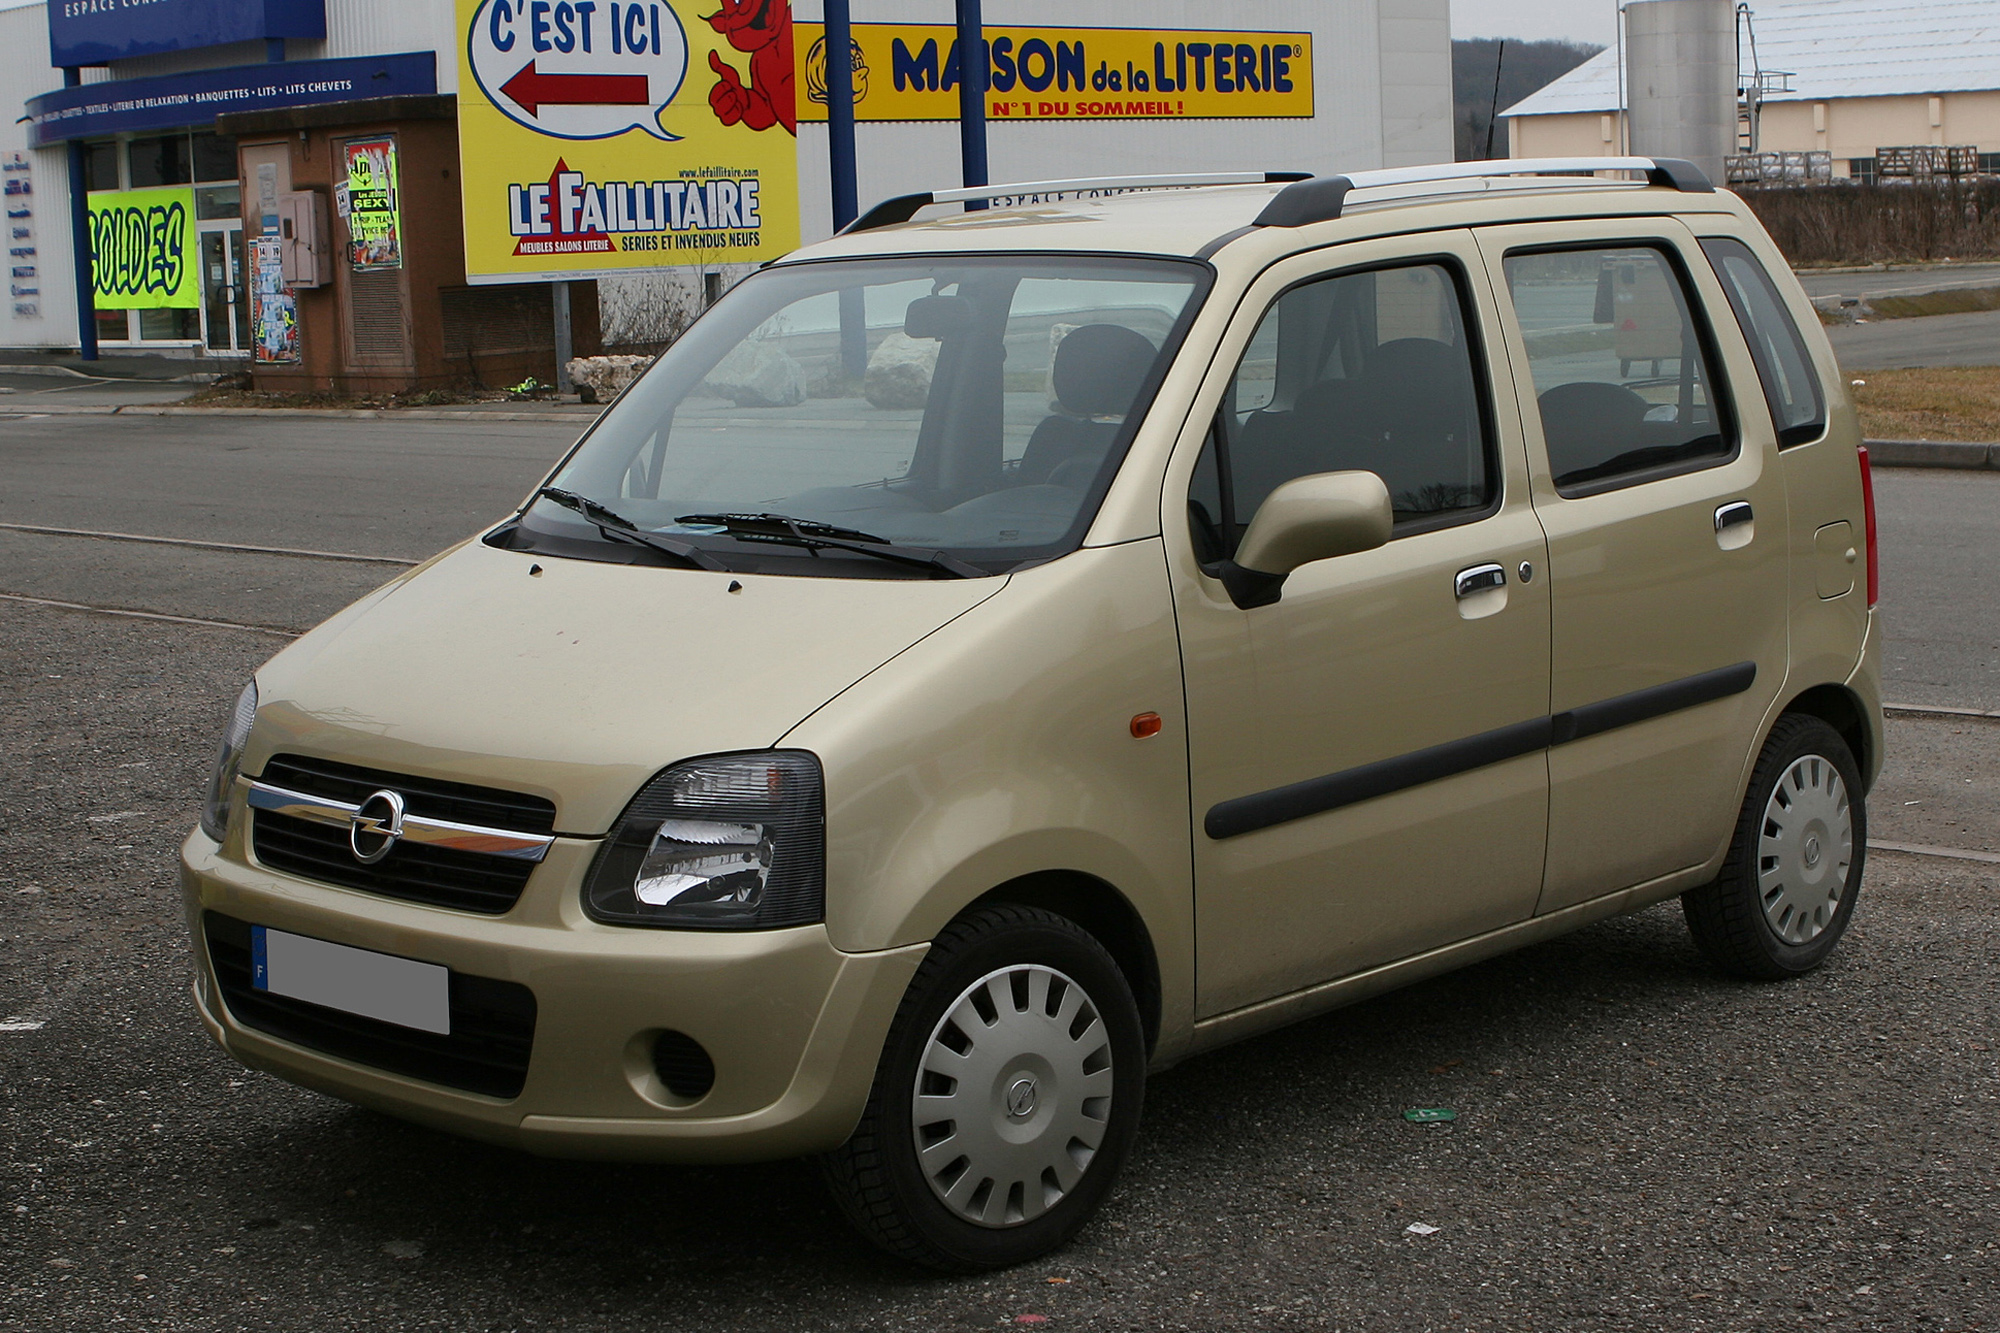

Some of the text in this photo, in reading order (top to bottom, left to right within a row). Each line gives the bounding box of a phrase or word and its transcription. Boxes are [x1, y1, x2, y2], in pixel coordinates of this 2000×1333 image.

[65, 0, 115, 17] ESPACE
[490, 0, 661, 56] C'EST ICI
[1091, 60, 1122, 92] de
[1127, 60, 1150, 92] la
[85, 103, 109, 115] TEXTILES
[113, 100, 135, 112] LITERIE
[135, 99, 145, 109] DE
[145, 93, 189, 108] RELAXATION
[195, 88, 250, 103] BANQUETTES
[257, 86, 277, 97] LITS
[285, 84, 306, 95] LITS
[308, 80, 352, 93] CHEVETS
[1039, 102, 1070, 116] DU
[679, 166, 759, 178] www.lefaillitaire.com
[354, 198, 390, 208] SEXY
[508, 171, 761, 236] LE FAILLITAIRE
[520, 239, 609, 253] MEUBLES SALONS LITERIE
[622, 231, 760, 251] SERIES ET INVENDUS NEUFS
[257, 965, 263, 978] F
